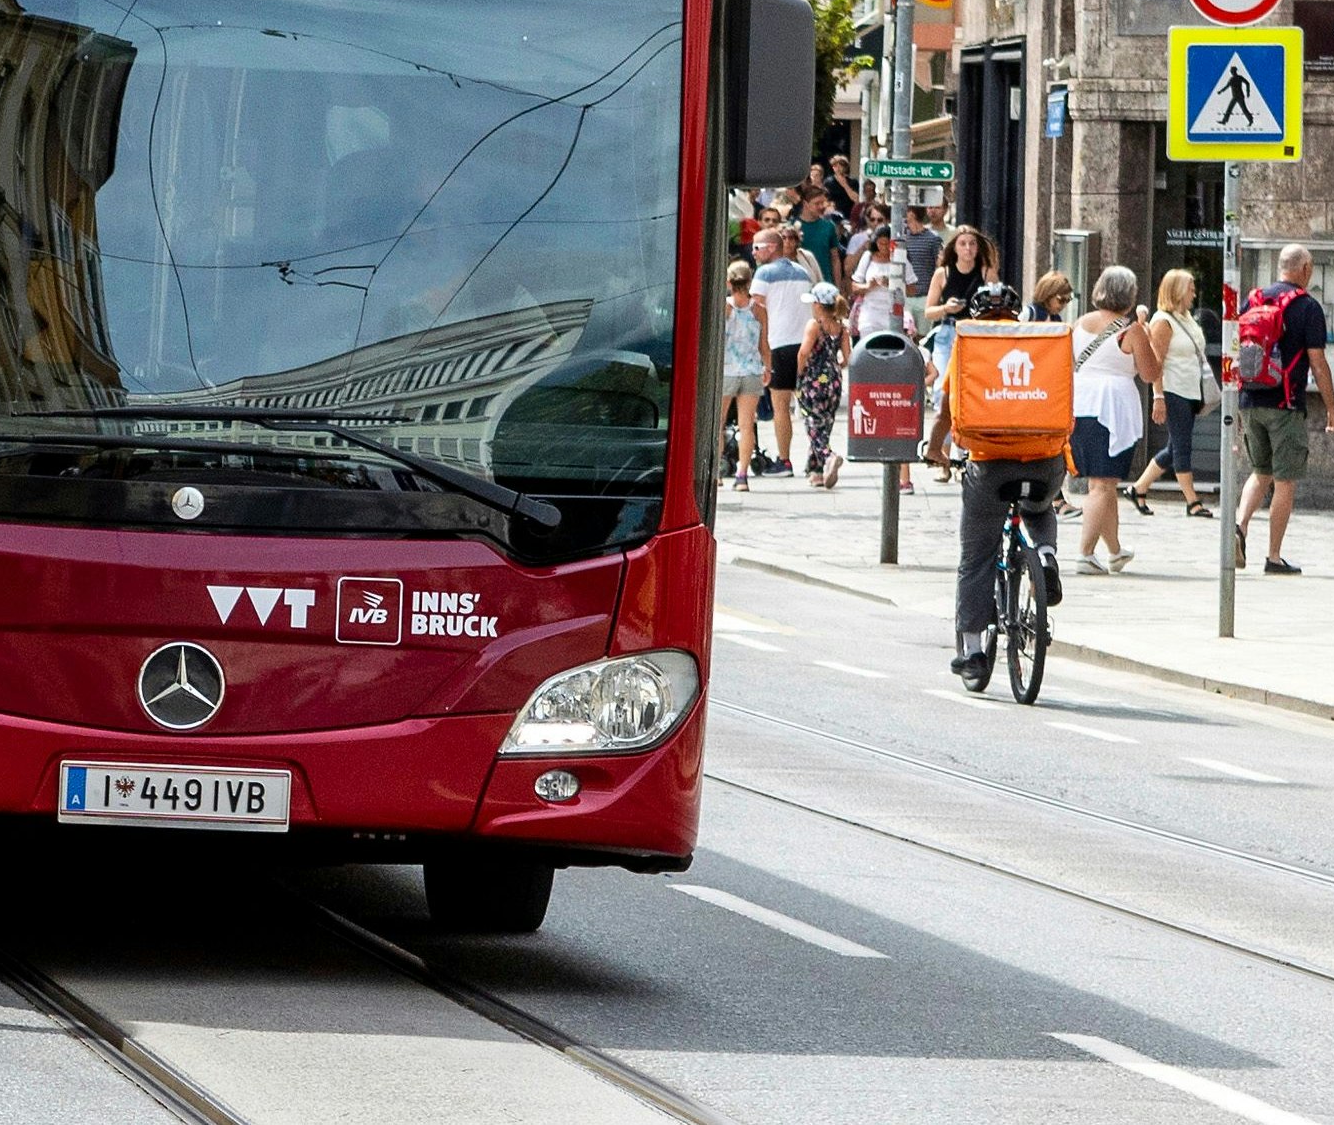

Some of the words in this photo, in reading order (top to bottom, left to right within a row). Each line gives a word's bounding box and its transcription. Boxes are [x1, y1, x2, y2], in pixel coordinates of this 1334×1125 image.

[984, 387, 1048, 401] Lieferando
[349, 608, 388, 625] IVB
[411, 613, 499, 638] BRUCK
[71, 794, 82, 806] A
